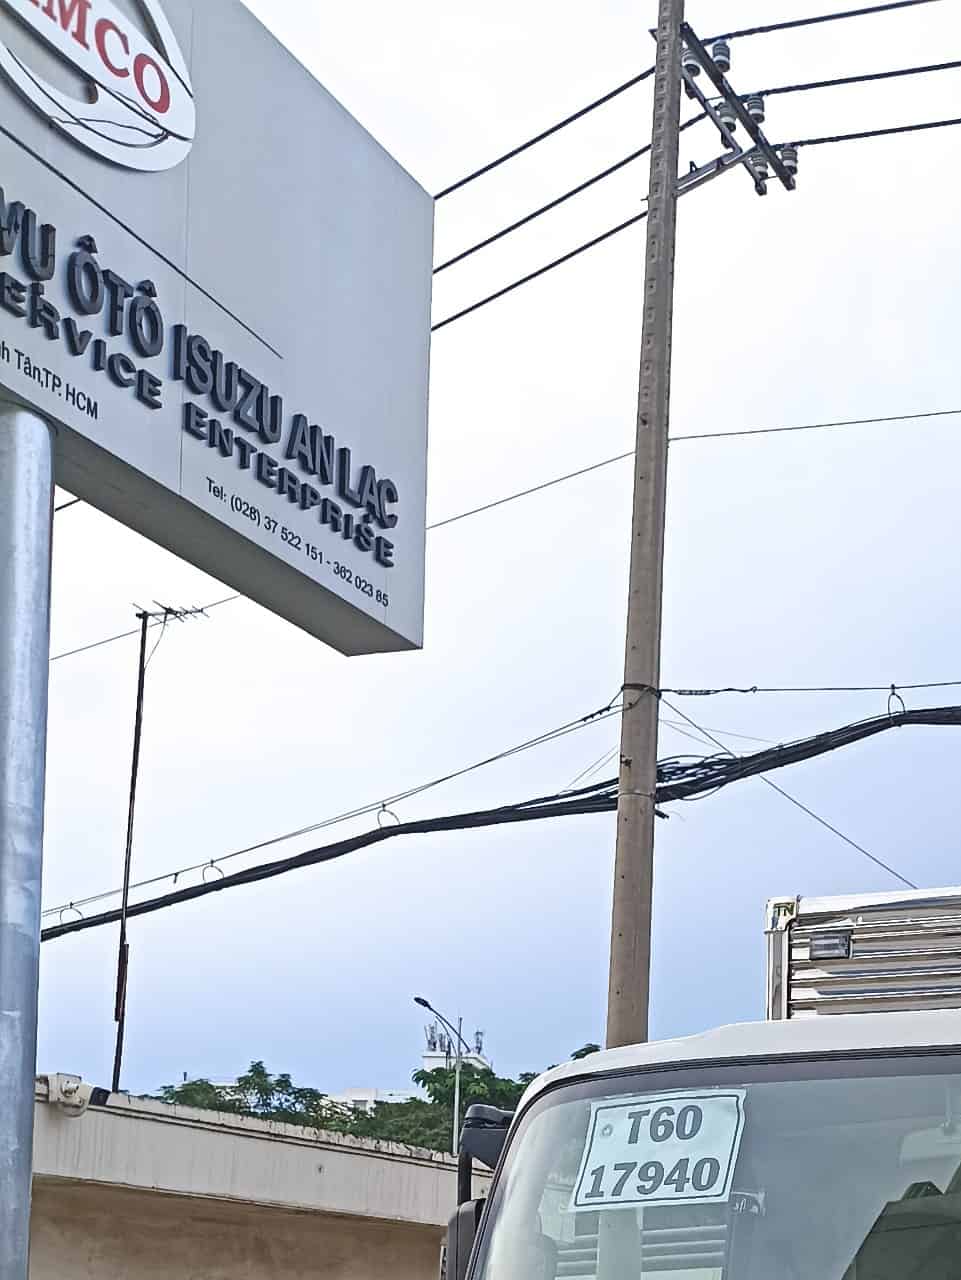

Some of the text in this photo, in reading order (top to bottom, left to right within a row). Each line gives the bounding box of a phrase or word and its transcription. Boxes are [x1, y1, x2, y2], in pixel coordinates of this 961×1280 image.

[30, 0, 171, 114] MCO
[0, 271, 395, 568] ERVICE ENTERPRISE
[65, 383, 98, 420] HCM
[172, 324, 283, 445] ISUZU
[286, 413, 335, 486] AN
[205, 476, 227, 502] Tel:
[230, 494, 261, 528] (028)
[263, 515, 279, 534] 37
[280, 527, 302, 550] 522
[305, 543, 324, 565] 151
[355, 575, 373, 598] 023
[773, 902, 796, 917] TN
[627, 1104, 703, 1145] T60
[584, 1157, 721, 1199] 17940
